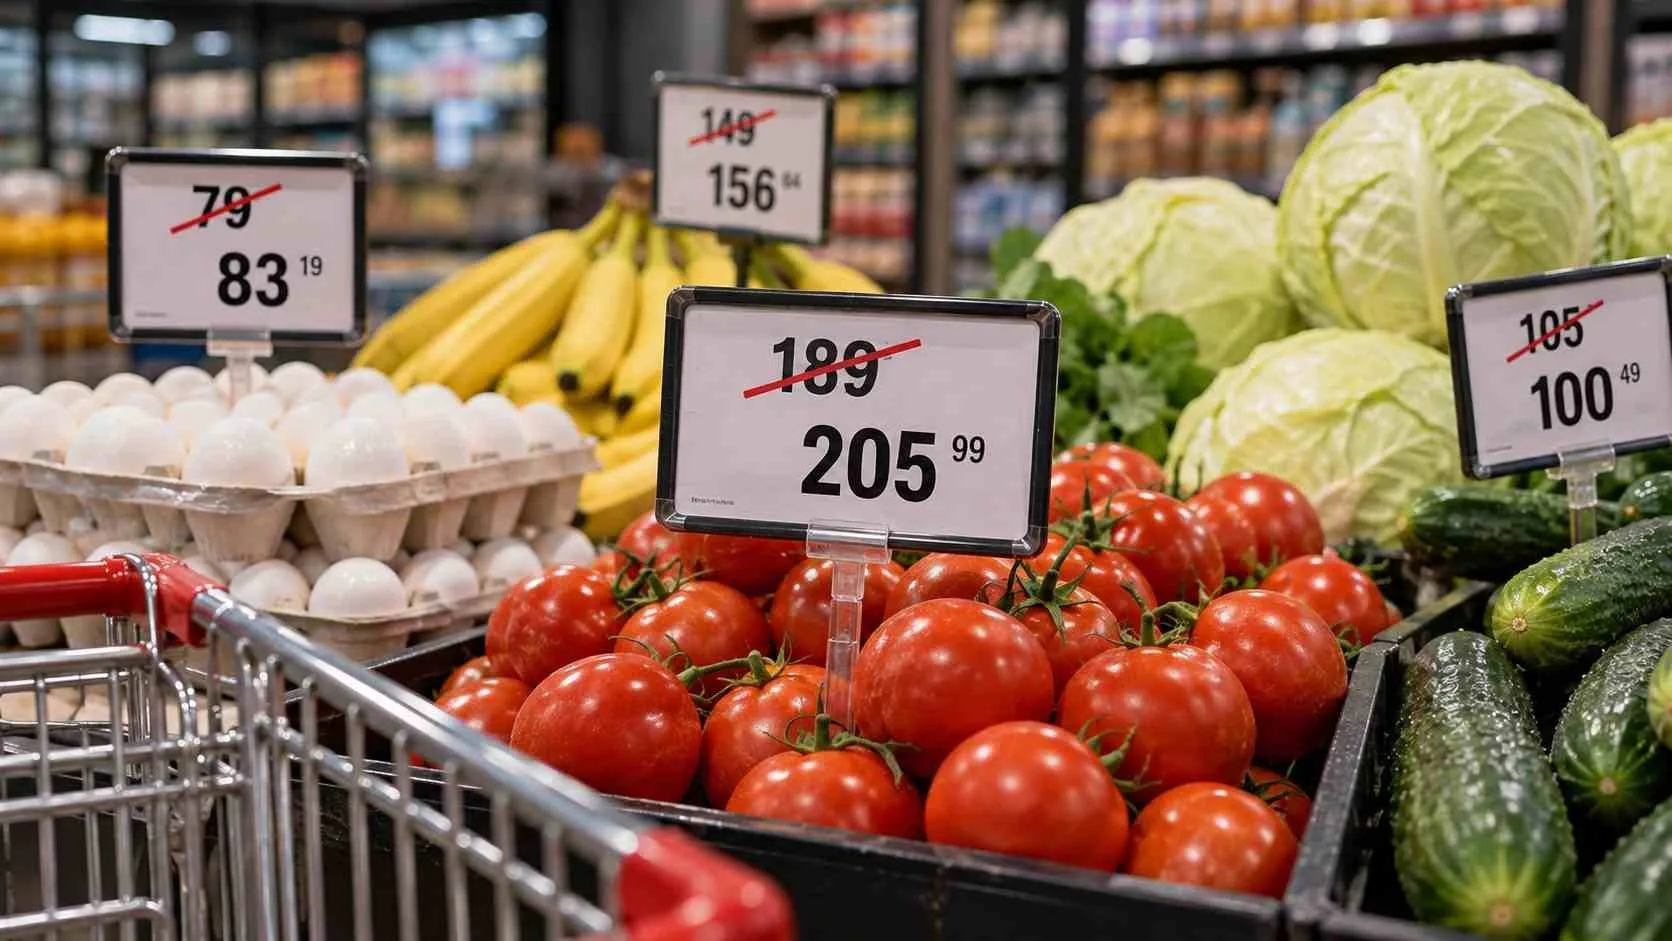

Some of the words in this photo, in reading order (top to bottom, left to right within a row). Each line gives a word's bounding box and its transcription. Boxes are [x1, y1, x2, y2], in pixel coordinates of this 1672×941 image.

[701, 107, 755, 146] 149
[192, 185, 252, 229] 79
[708, 163, 776, 212] 156
[218, 252, 289, 307] 83
[300, 255, 323, 276] 19
[1519, 306, 1584, 354] 105
[772, 337, 879, 398] 189
[1530, 366, 1614, 430] 100
[1619, 361, 1641, 384] 49
[801, 424, 936, 503] 205
[952, 434, 985, 464] 99
